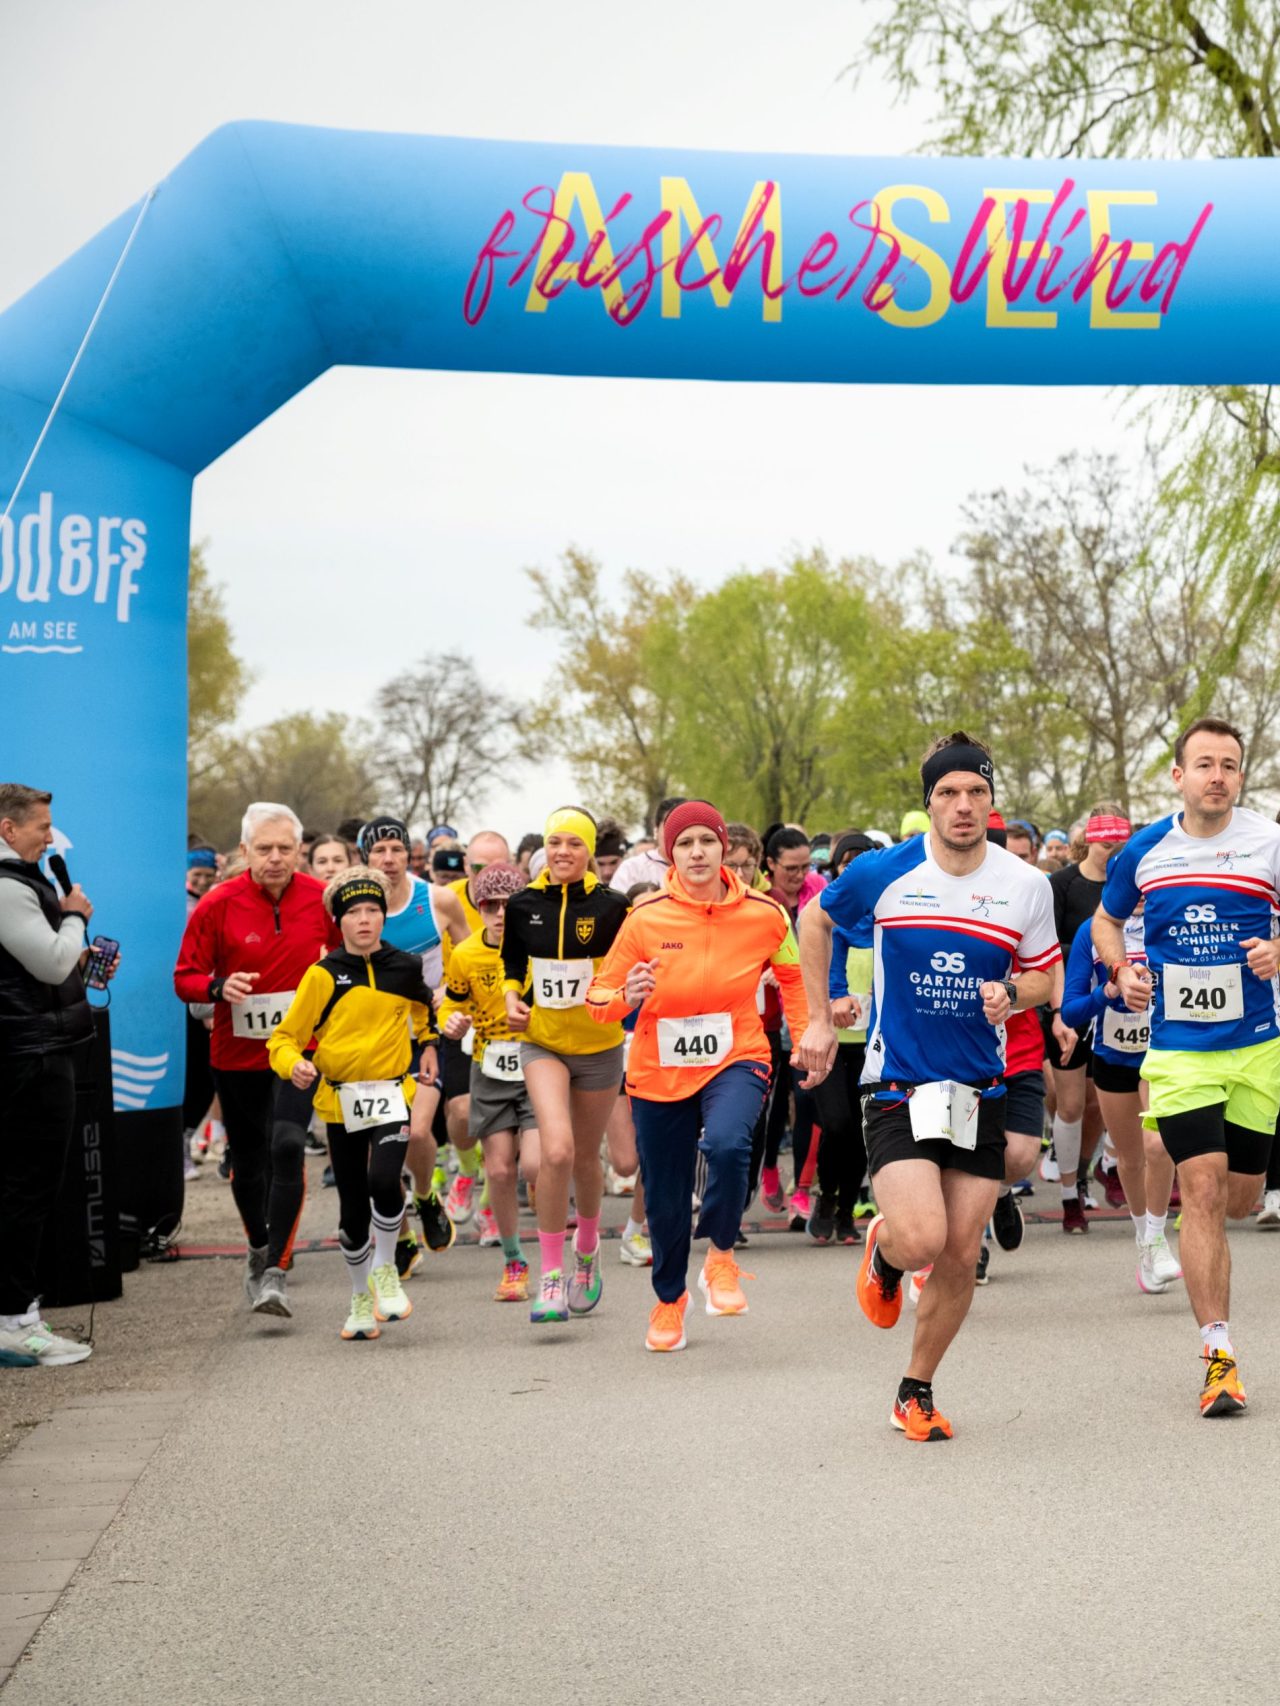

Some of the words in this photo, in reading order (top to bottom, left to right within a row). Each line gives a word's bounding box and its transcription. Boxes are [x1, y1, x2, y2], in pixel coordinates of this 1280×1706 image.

[525, 172, 782, 322] AM
[870, 184, 1162, 330] SEE
[949, 177, 1214, 315] Wind
[9, 621, 37, 640] AM
[43, 621, 77, 640] SEE
[1168, 922, 1241, 937] GARTNER
[661, 942, 684, 950] JAKO
[1176, 933, 1235, 946] SCHIENER
[1193, 945, 1219, 956] BAU
[542, 978, 580, 998] 517
[909, 971, 984, 989] GARTNER
[915, 986, 977, 1001] SCHIENER
[1179, 987, 1227, 1010] 240
[933, 1000, 958, 1010] BAU
[673, 1033, 718, 1057] 440
[1114, 1026, 1149, 1045] 449
[353, 1097, 392, 1119] 472
